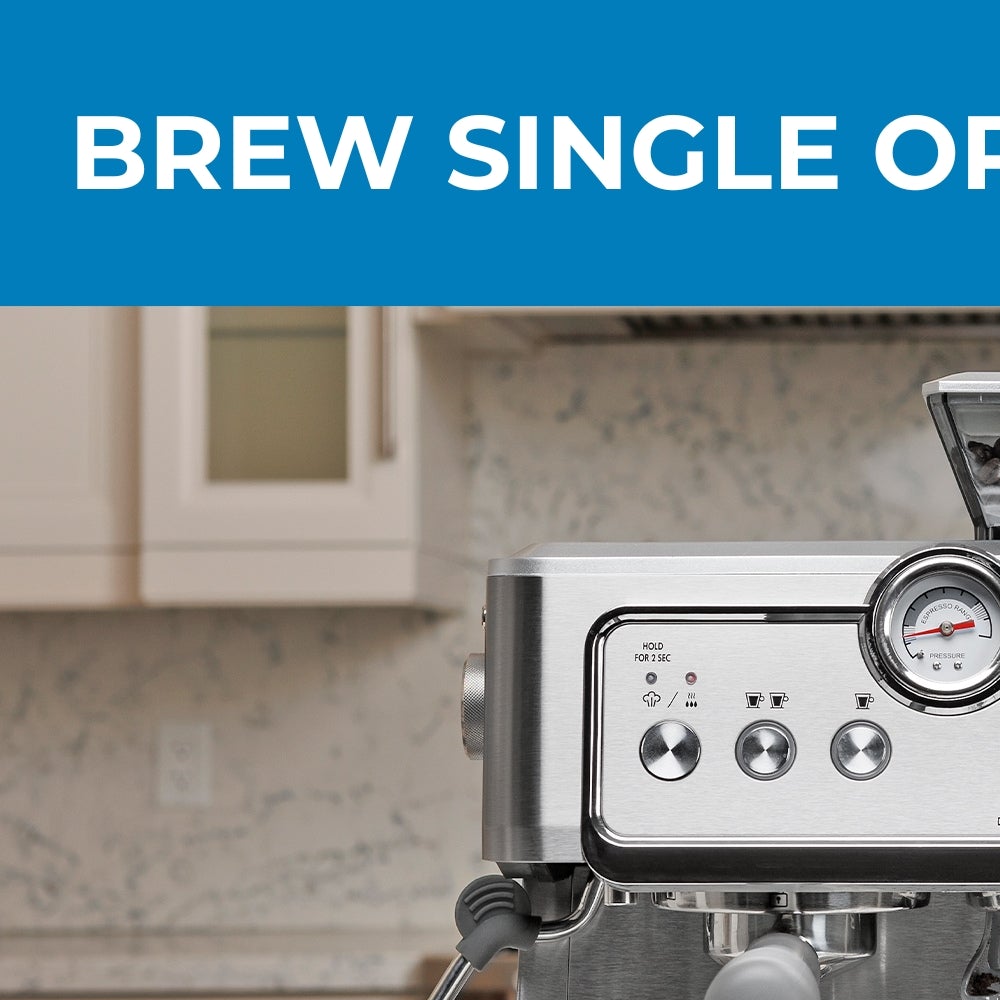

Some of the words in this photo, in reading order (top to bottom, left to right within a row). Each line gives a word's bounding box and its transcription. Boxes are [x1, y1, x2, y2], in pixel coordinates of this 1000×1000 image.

[920, 602, 952, 625] ESPRESSO
[953, 604, 974, 621] RANG
[642, 641, 664, 651] HOLD
[634, 653, 650, 663] FOR
[651, 653, 656, 663] 2
[657, 653, 671, 663] SEC
[929, 652, 966, 660] PRESSURE
